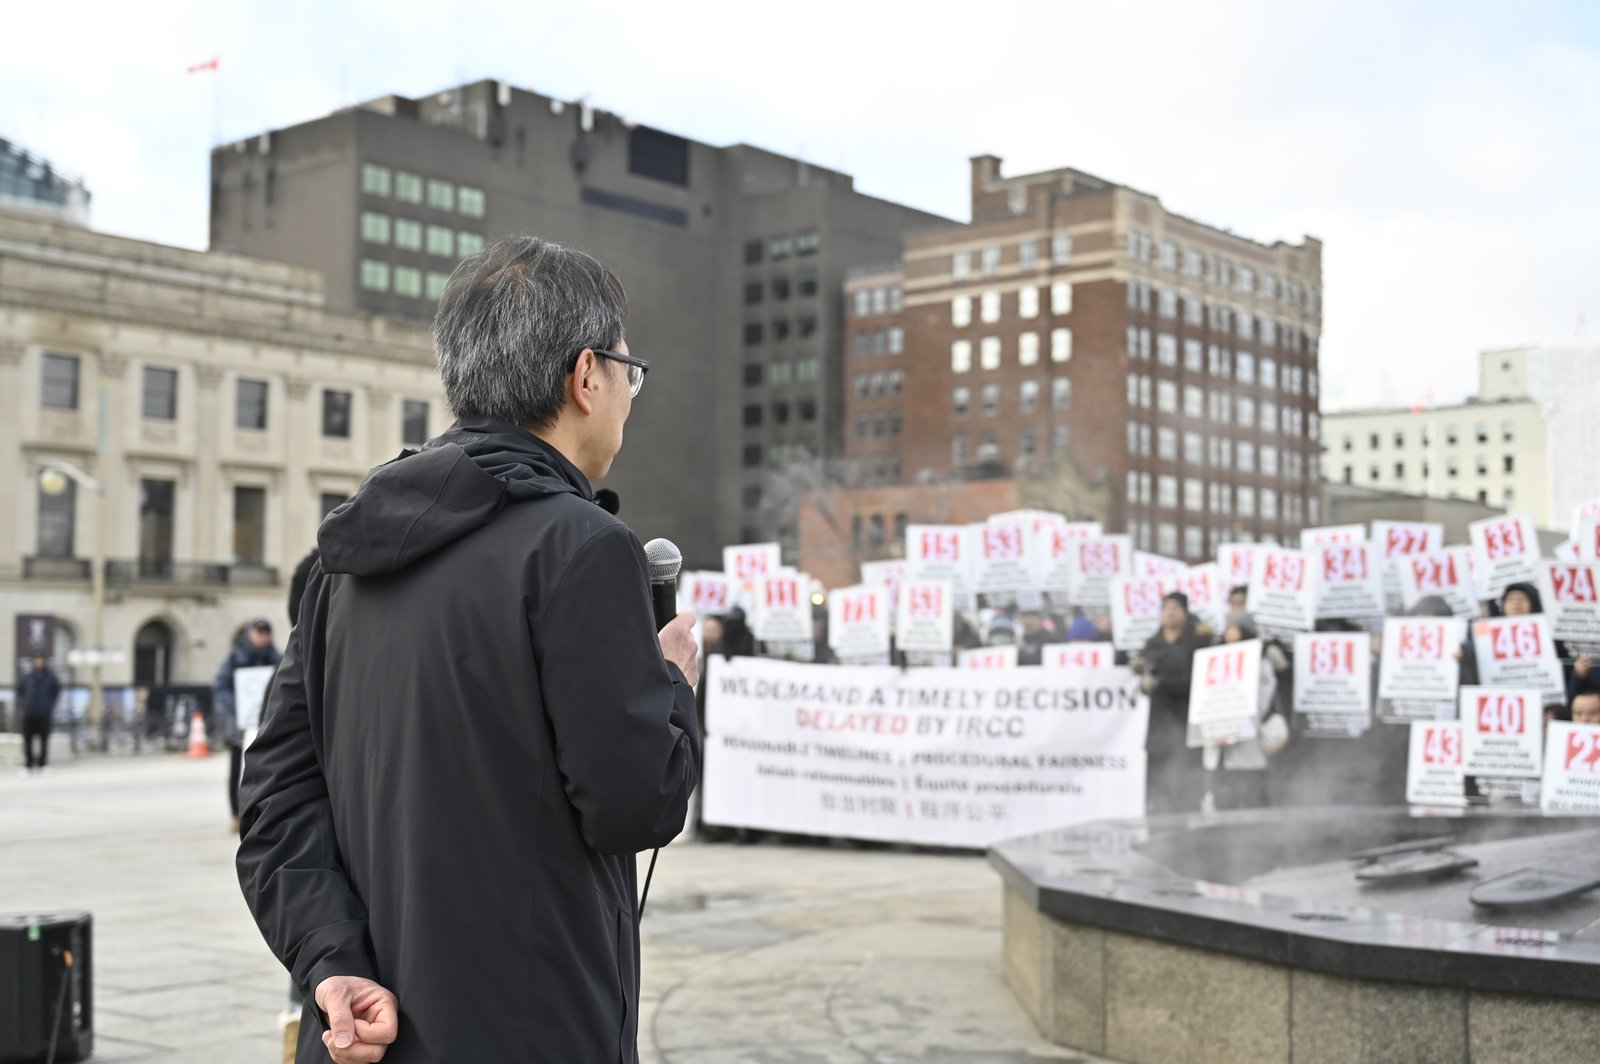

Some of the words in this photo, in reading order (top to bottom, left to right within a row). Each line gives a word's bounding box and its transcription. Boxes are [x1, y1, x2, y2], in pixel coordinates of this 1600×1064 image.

[1484, 520, 1526, 559] 33
[1550, 565, 1598, 602] 24
[1399, 624, 1444, 659] 33
[1491, 622, 1541, 660] 46
[755, 680, 862, 704] DEMAND
[869, 688, 885, 706] A
[895, 687, 985, 709] TIMELY
[995, 687, 1138, 710] DECISION
[795, 708, 909, 734] DELAYED
[916, 716, 946, 735] BY
[957, 716, 1025, 738] IRCC
[1477, 696, 1524, 734] 40
[1424, 728, 1462, 764] 43
